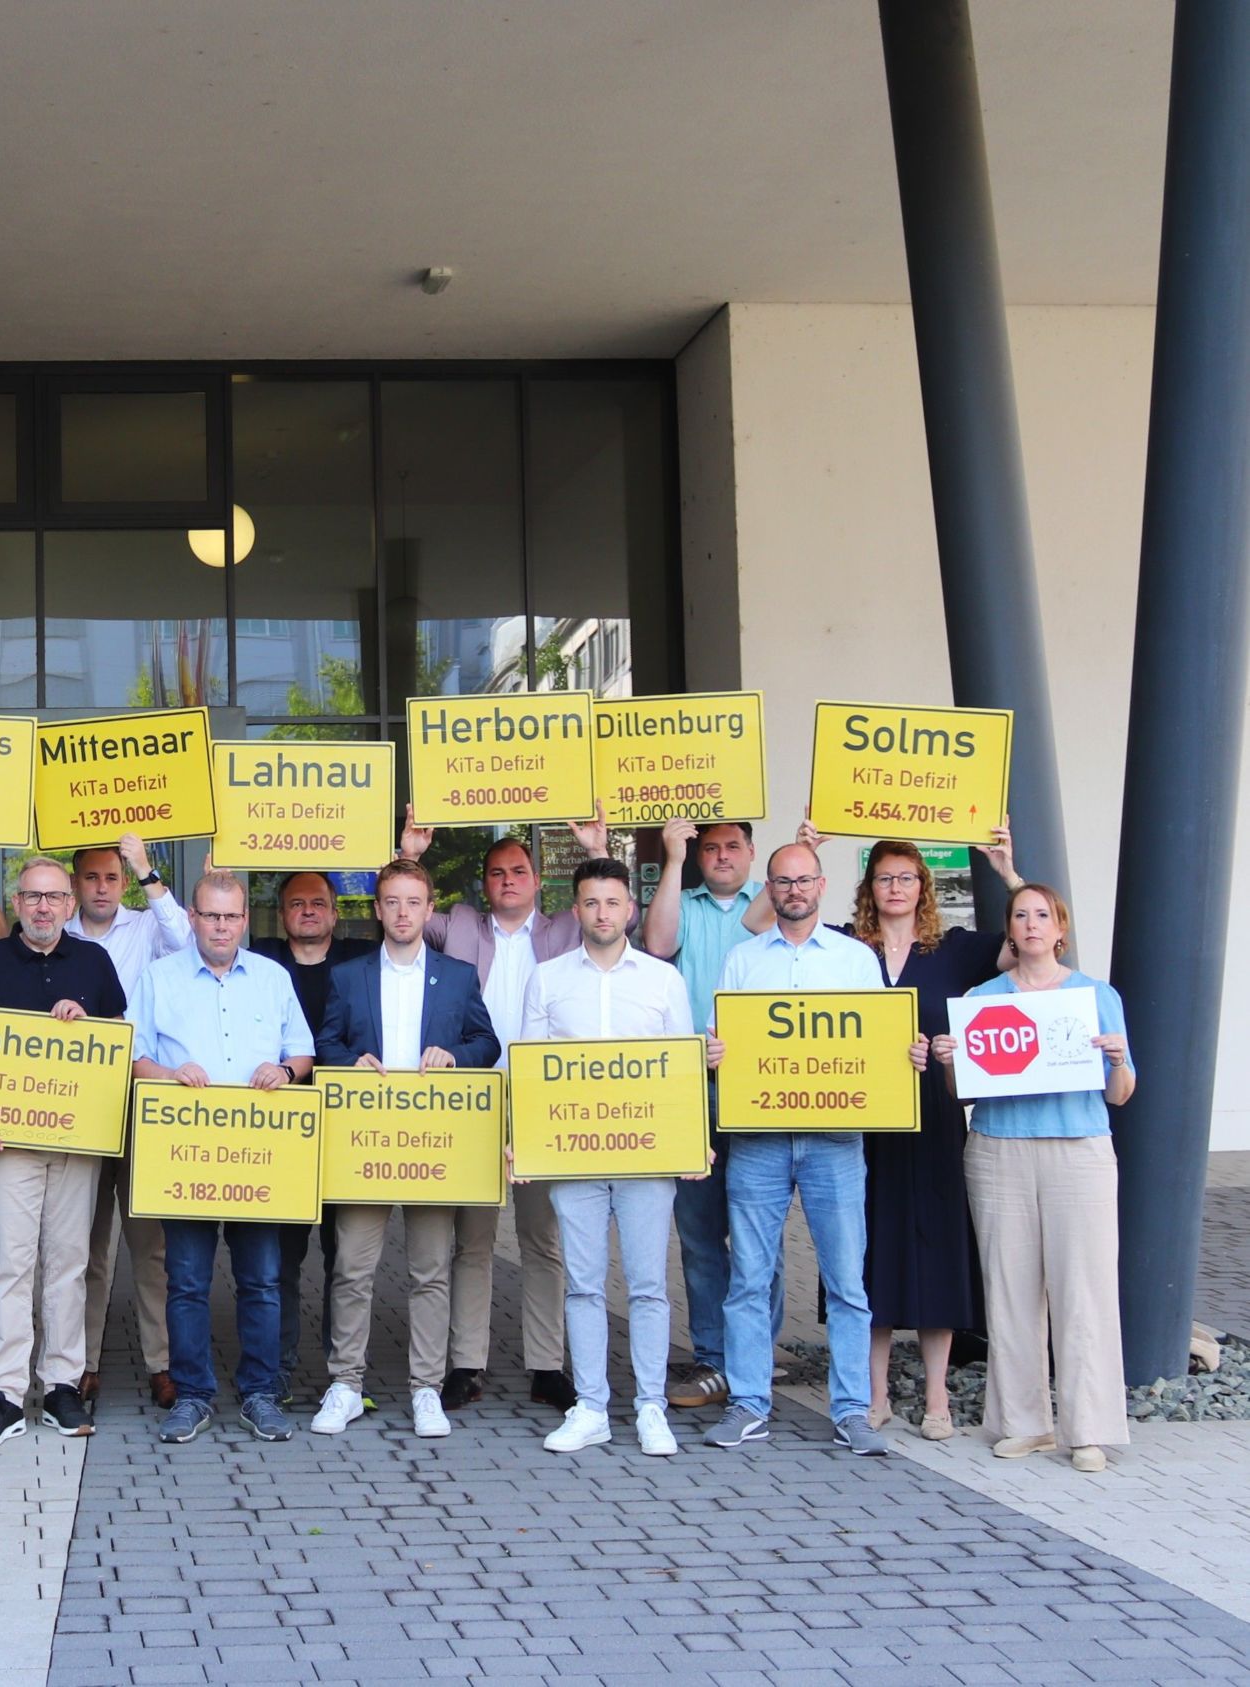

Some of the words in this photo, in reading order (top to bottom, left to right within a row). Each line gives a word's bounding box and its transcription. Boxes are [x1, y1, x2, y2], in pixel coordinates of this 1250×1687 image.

[421, 707, 583, 744] Herborn
[596, 709, 743, 739] Dillenburg
[842, 714, 975, 758] Solms
[40, 730, 194, 766] Mittenaar
[228, 752, 371, 788] Lahnau
[446, 757, 485, 774] KiTa
[491, 754, 545, 772] Defizit
[618, 757, 656, 773] KiTa
[662, 753, 716, 771] Defizit
[70, 780, 108, 798] KiTa
[114, 774, 167, 793] Defizit
[852, 767, 893, 786] KiTa
[900, 770, 957, 790] Defizit
[442, 786, 548, 806] -8.600.000€
[70, 803, 173, 827] -1.370.000€
[248, 802, 286, 818] KiTa
[292, 802, 345, 819] Defizit
[609, 801, 724, 821] -11.000.000€
[844, 800, 954, 824] -5.454.701€
[240, 833, 346, 851] -3.249.000€
[768, 1001, 862, 1039] Sinn
[968, 1026, 1036, 1056] STOP
[543, 1051, 669, 1081] Driedorf
[758, 1057, 800, 1075] KiTa
[807, 1057, 866, 1075] Defizit
[23, 1076, 79, 1097] Defizit
[325, 1083, 491, 1111] Breitscheid
[751, 1091, 867, 1110] -2.300.000€
[141, 1097, 316, 1138] Eschenburg
[549, 1104, 590, 1120] KiTa
[597, 1103, 654, 1120] Defizit
[351, 1131, 390, 1147] KiTa
[397, 1131, 453, 1148] Defizit
[546, 1132, 656, 1152] -1.700.000€
[171, 1144, 210, 1162] KiTa
[216, 1146, 273, 1165] Defizit
[354, 1162, 447, 1180] -810.000€
[164, 1182, 271, 1203] -3.182.000€
